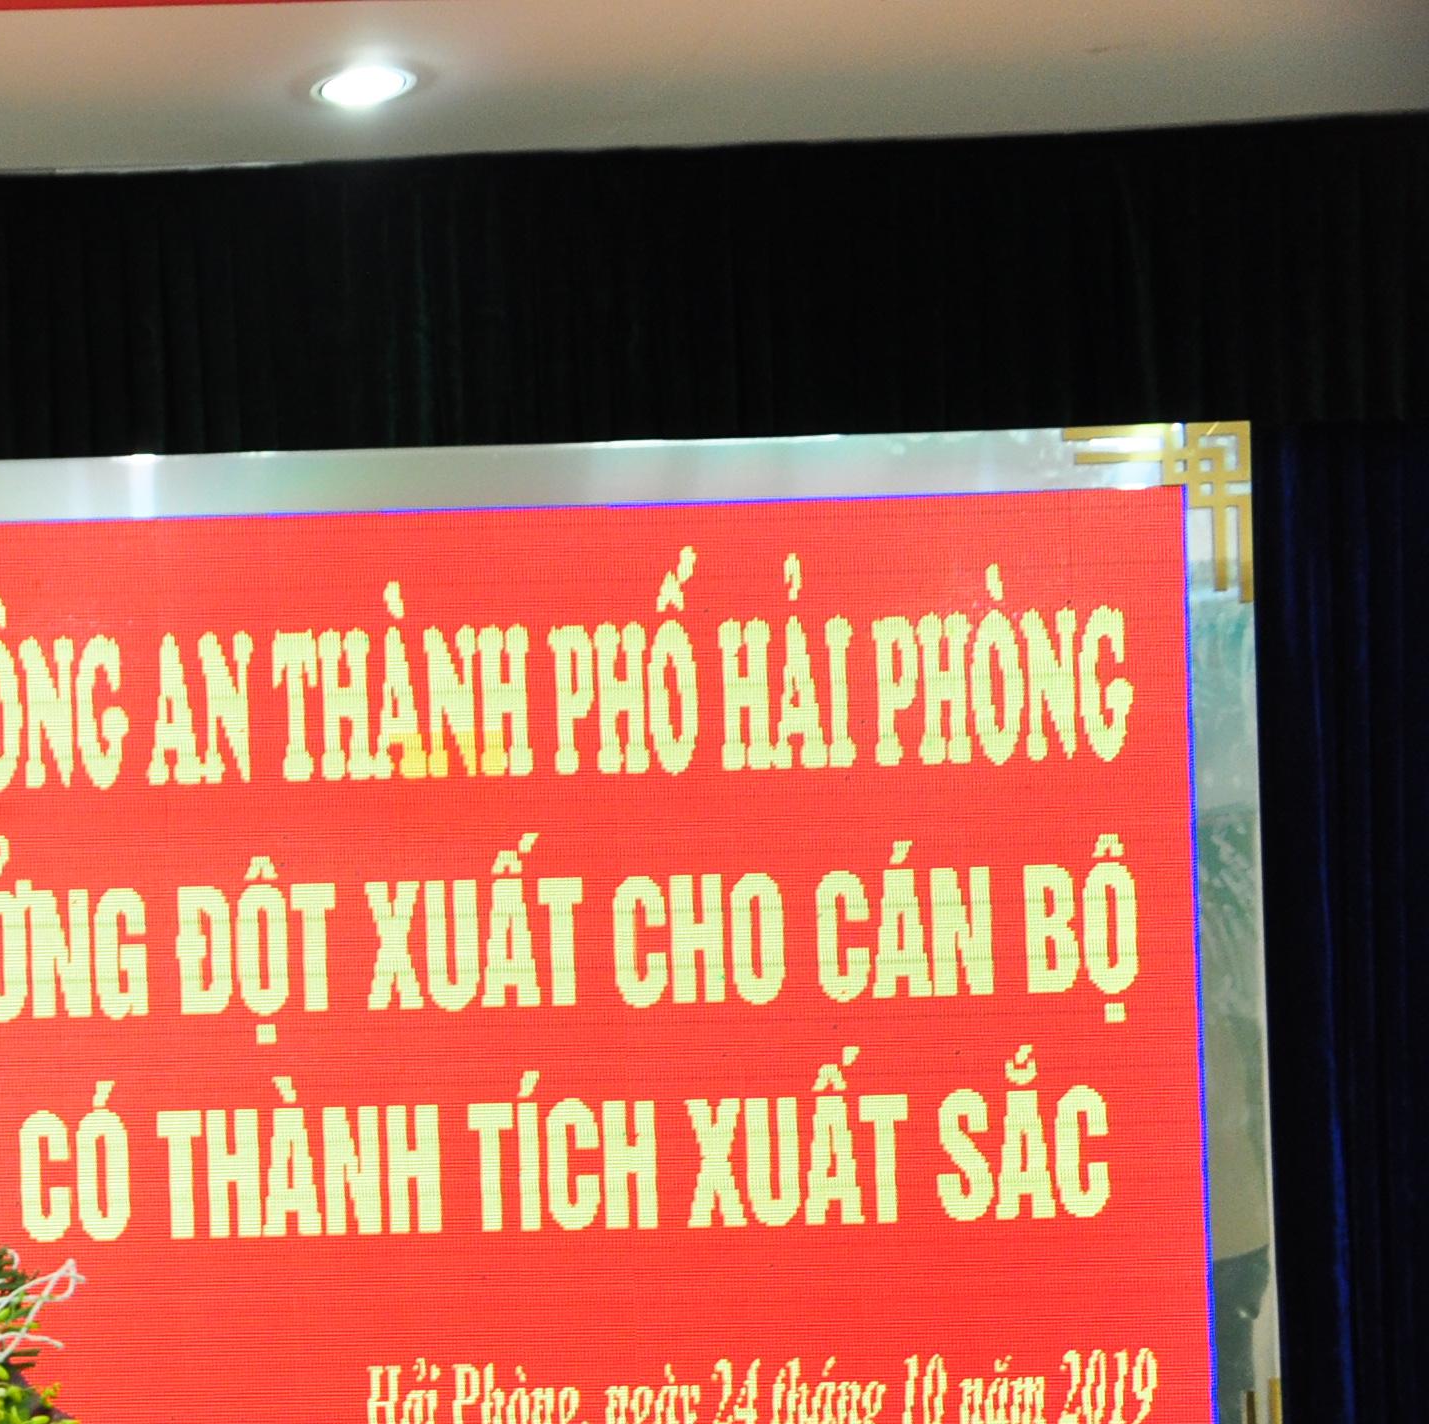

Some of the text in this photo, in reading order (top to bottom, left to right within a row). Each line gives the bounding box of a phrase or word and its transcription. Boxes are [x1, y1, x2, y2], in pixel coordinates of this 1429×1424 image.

[147, 631, 253, 786] AN
[272, 582, 533, 783] THÀNH
[548, 546, 698, 776] PHỐ
[718, 553, 857, 771] HẢI
[872, 564, 1135, 767] PHÒNG
[176, 856, 337, 1044] ĐỘT
[365, 833, 584, 1013] XUẤT
[613, 873, 785, 1009] CHO
[816, 841, 994, 1003] CÁN
[1024, 834, 1139, 1024] BỘ
[19, 1080, 132, 1243] CÓ
[157, 1076, 443, 1240] THÀNH
[468, 1071, 659, 1232] TÍCH
[685, 1048, 909, 1229] XUẤT
[937, 1045, 1111, 1222] SẮC
